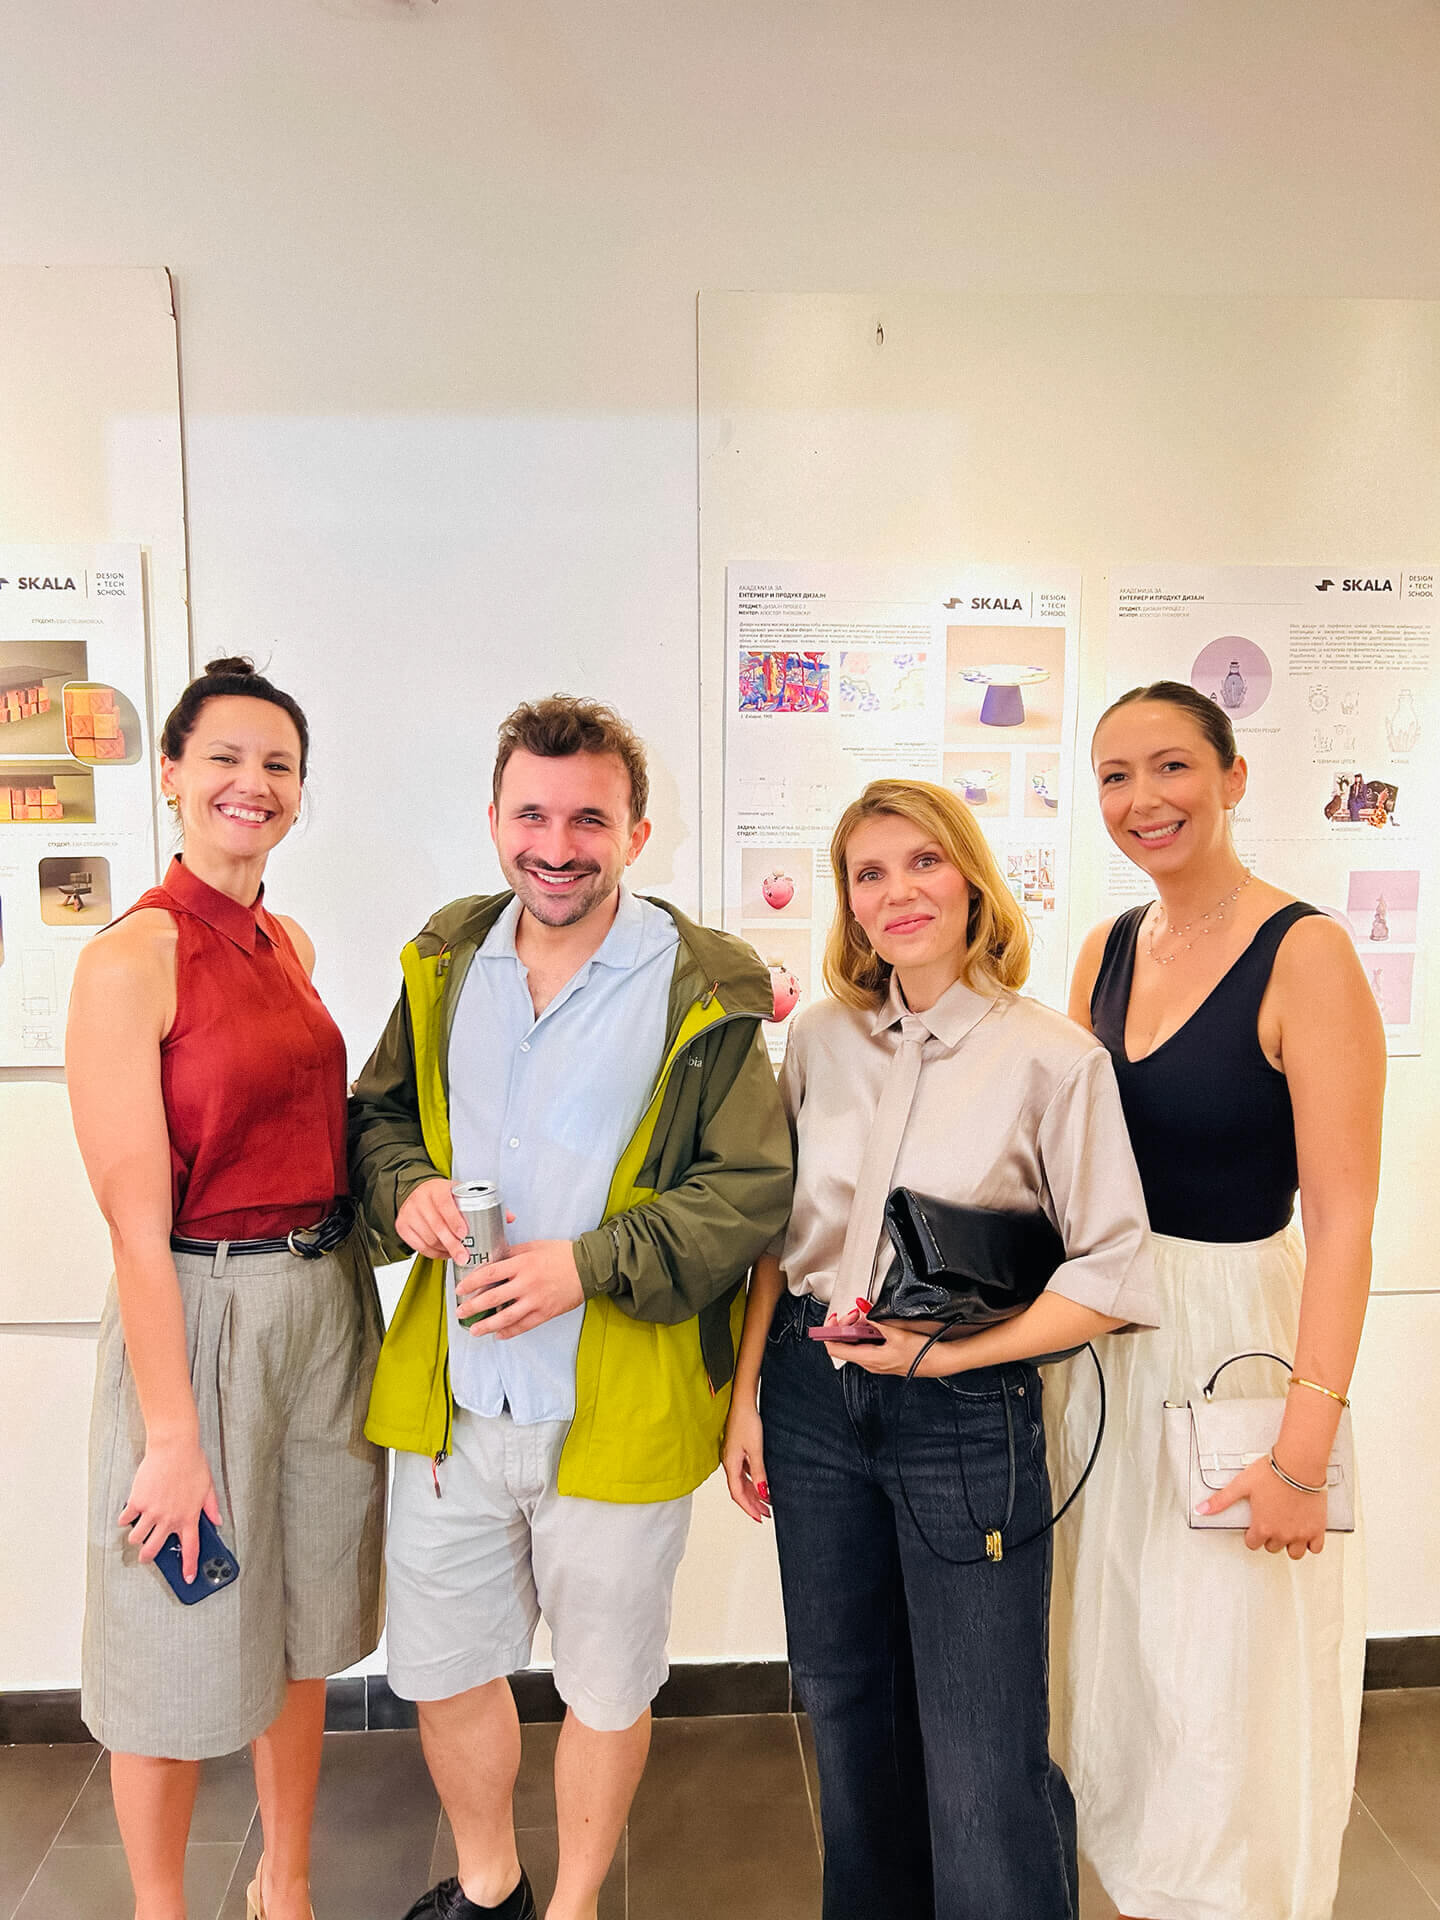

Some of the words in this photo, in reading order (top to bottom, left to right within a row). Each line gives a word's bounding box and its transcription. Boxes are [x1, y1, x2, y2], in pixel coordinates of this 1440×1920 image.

[18, 577, 76, 590] SKALA
[1342, 579, 1393, 592] SKALA
[971, 597, 1022, 610] SKALA
